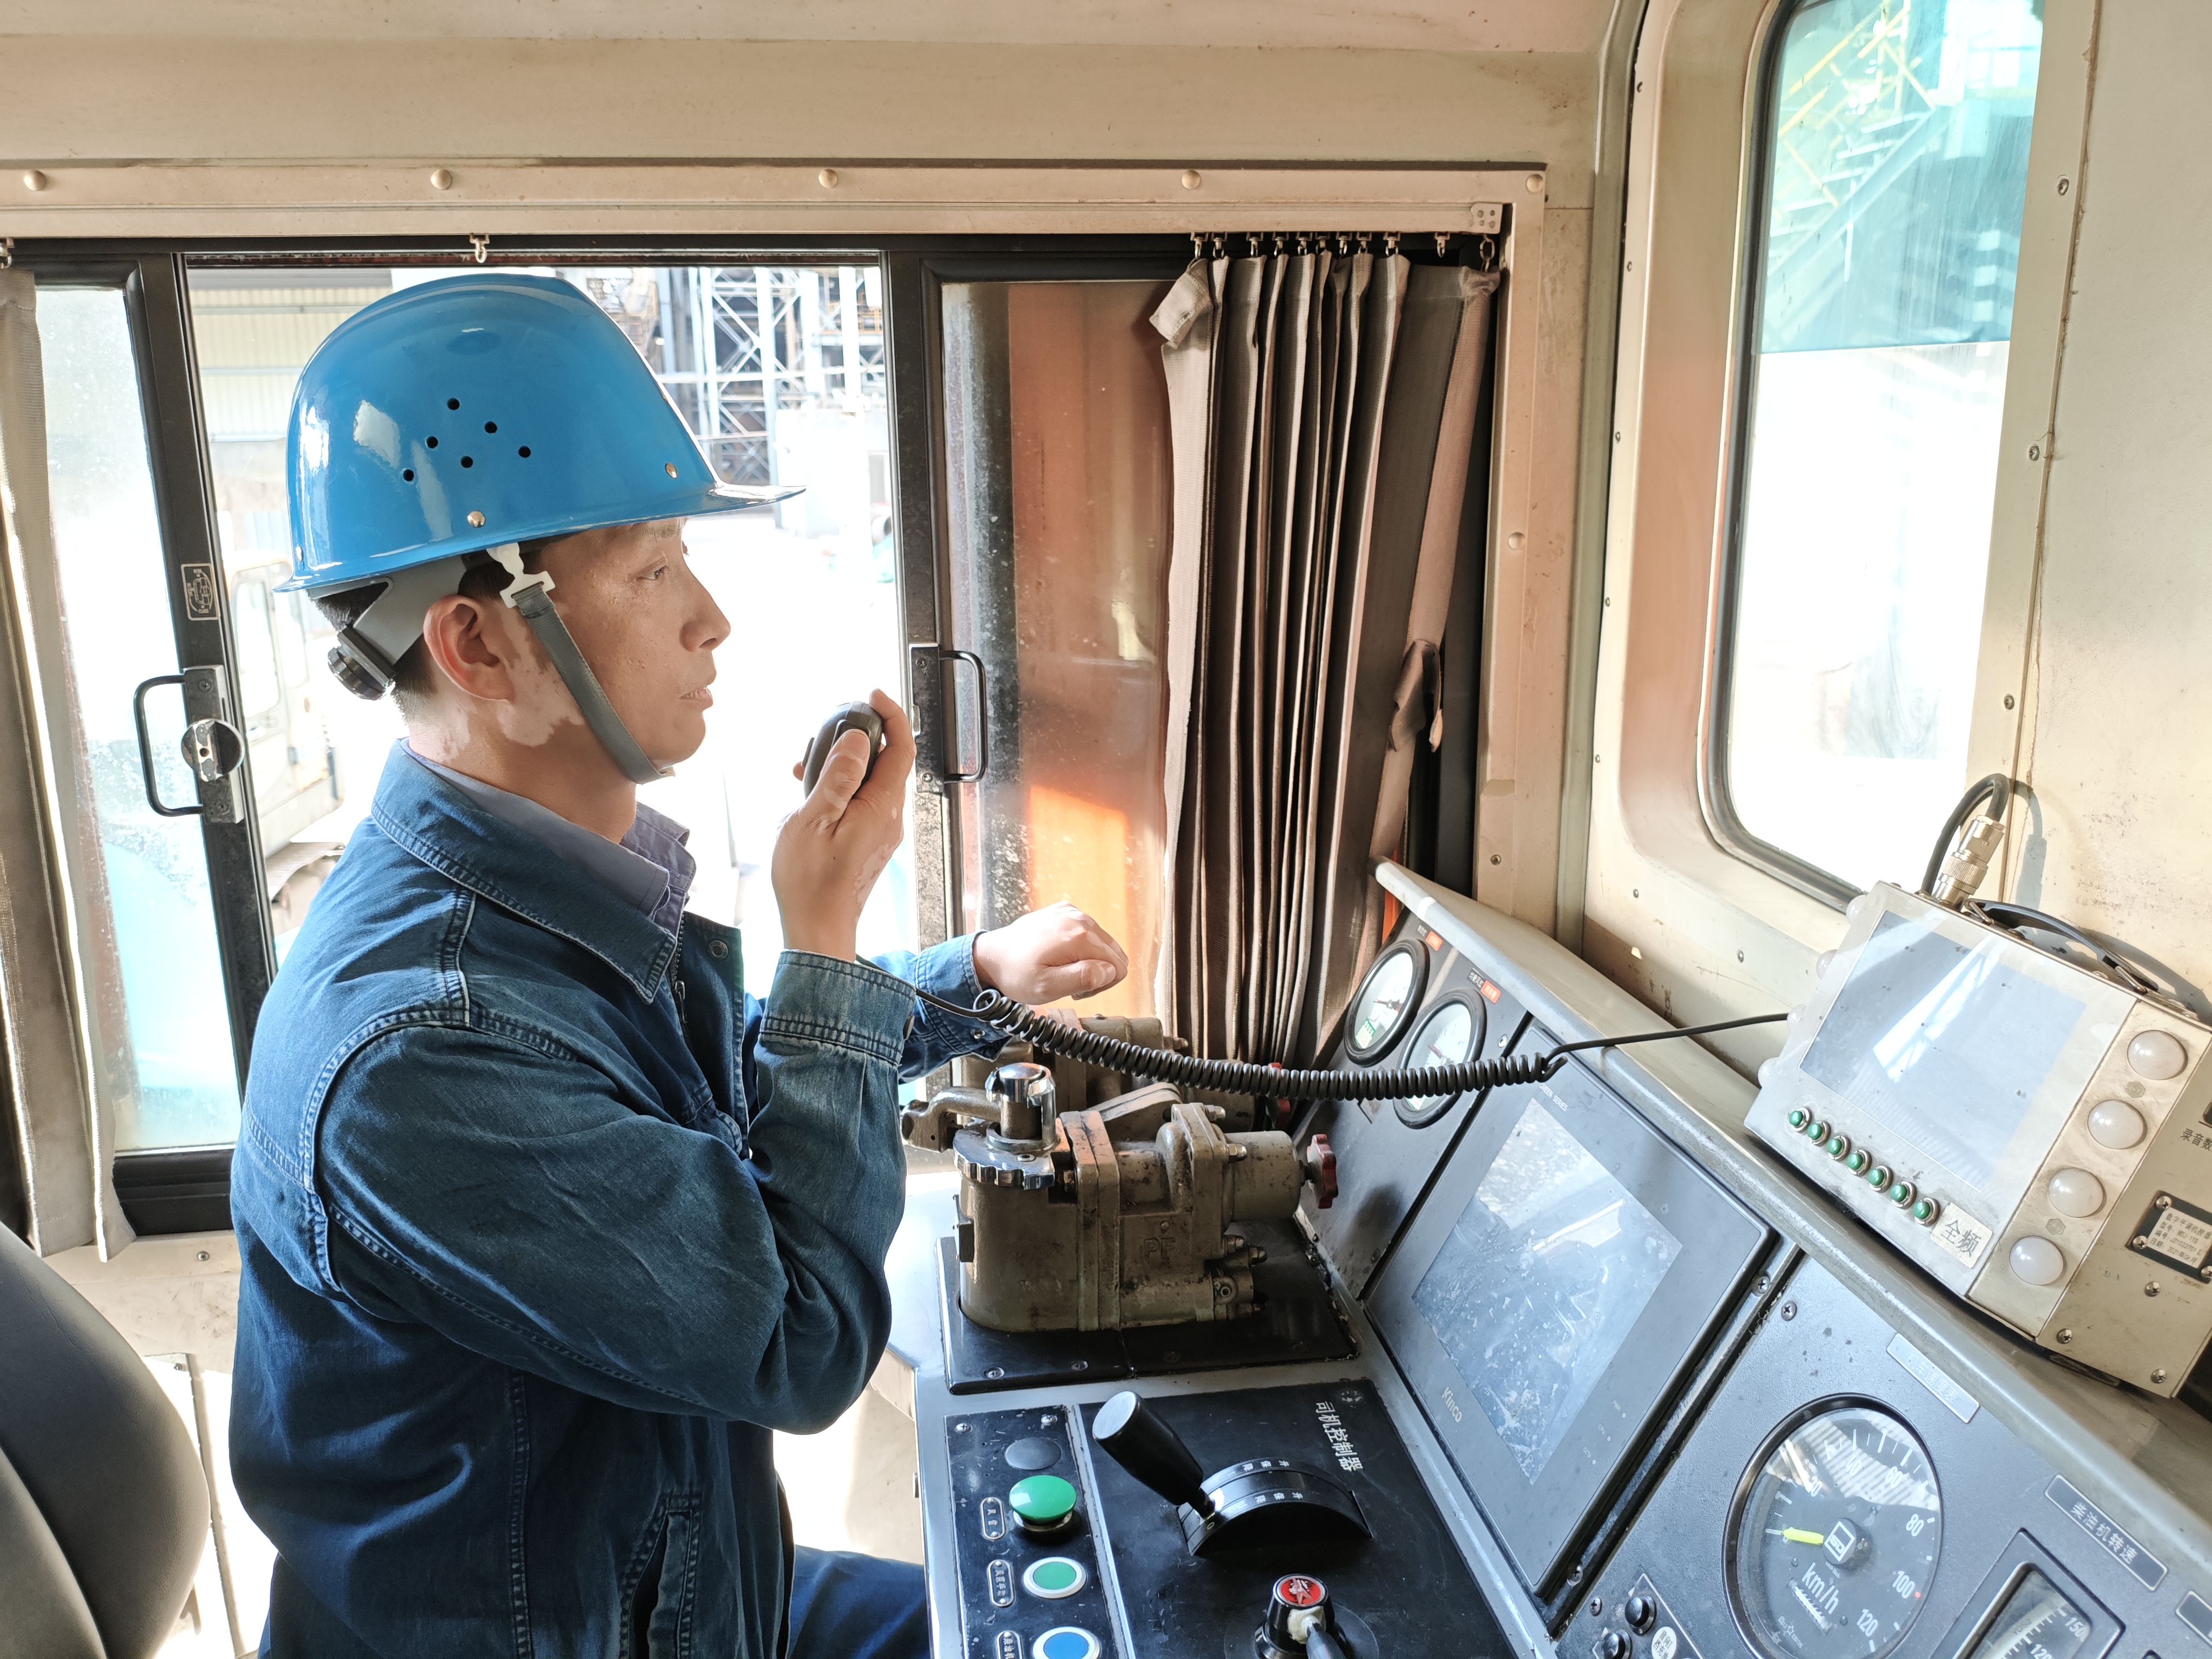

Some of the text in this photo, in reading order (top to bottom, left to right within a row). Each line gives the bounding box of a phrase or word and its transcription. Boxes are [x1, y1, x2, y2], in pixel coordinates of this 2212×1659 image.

[1940, 1219, 1982, 1258] 全频
[1907, 1353, 1959, 1404] 机车速度表
[1441, 1386, 1462, 1422] Kinco
[1316, 1401, 1364, 1472] 司机控制器
[1885, 1466, 1904, 1488] 60
[1905, 1514, 1924, 1537] 80
[2071, 1501, 2137, 1564] 柴油机转速
[1801, 1562, 1839, 1615] km/h
[1892, 1570, 1916, 1599] 100
[1856, 1608, 1878, 1637] 120
